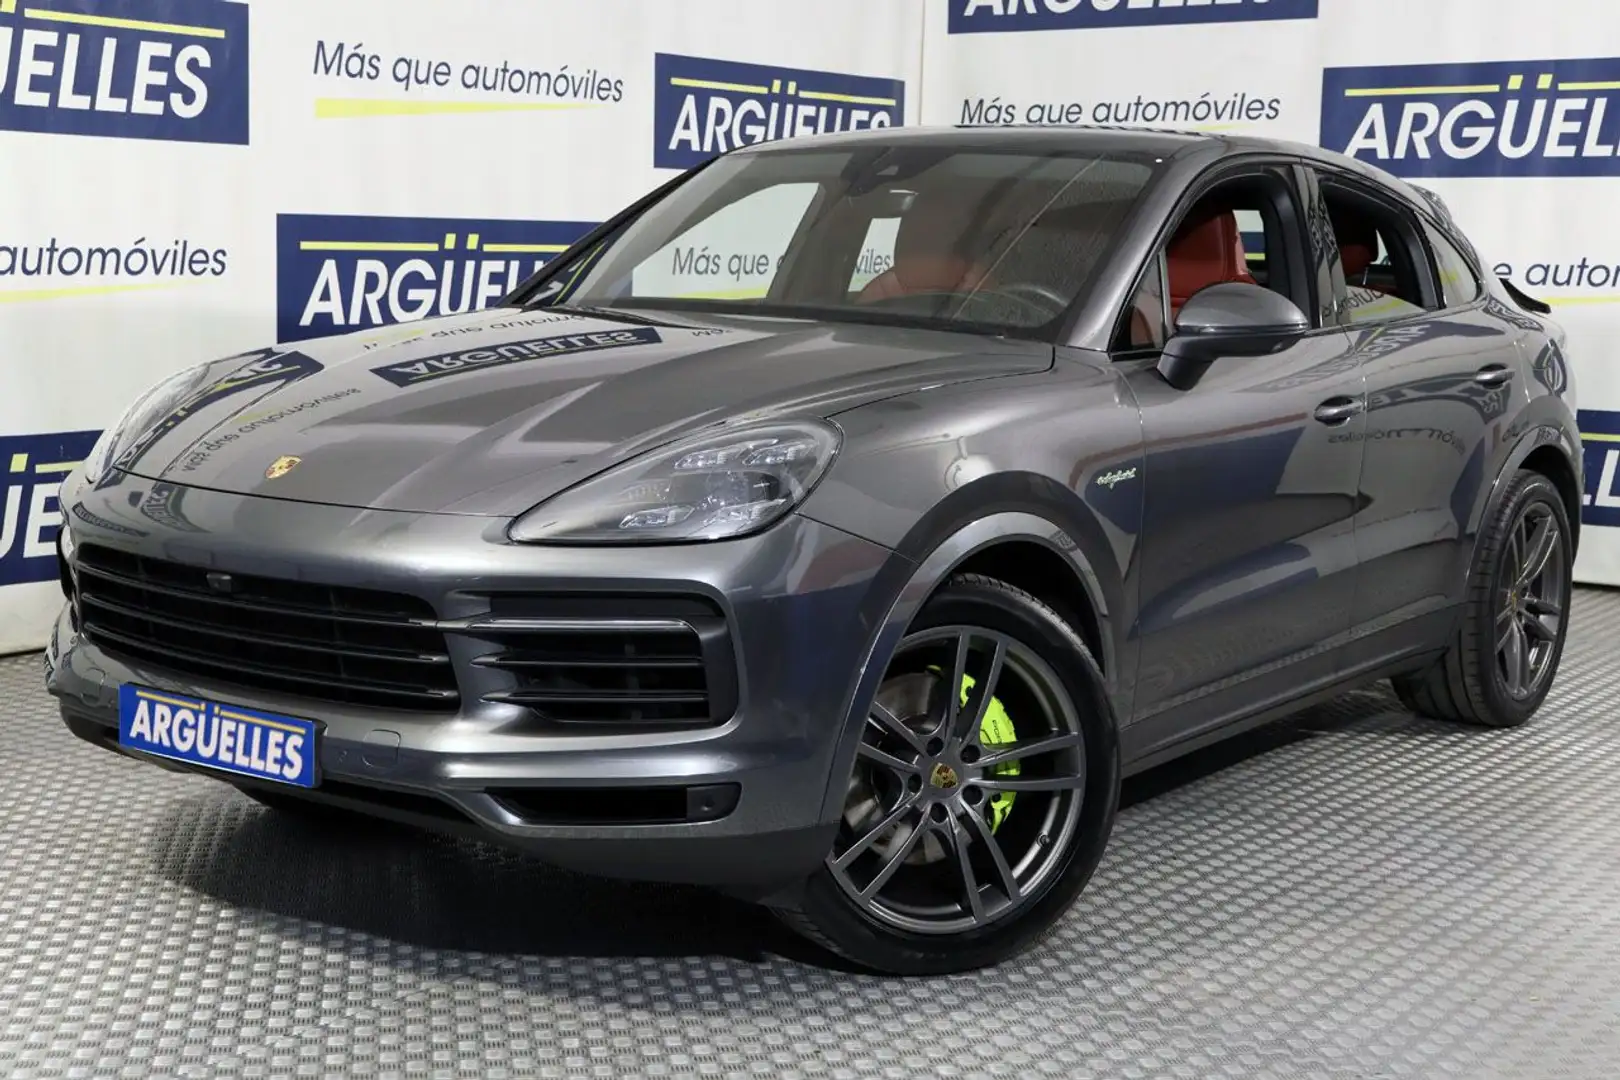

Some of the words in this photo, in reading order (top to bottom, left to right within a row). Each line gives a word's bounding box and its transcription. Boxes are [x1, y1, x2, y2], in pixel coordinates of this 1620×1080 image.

[313, 40, 381, 80] Más
[392, 57, 451, 91] que
[460, 60, 624, 102] automóviles
[960, 97, 1016, 124] Más
[1092, 92, 1281, 124] automóviles
[1343, 73, 1620, 160] ARGÜEL
[672, 246, 721, 275] Más
[727, 253, 769, 282] que
[1525, 257, 1620, 287] auto
[130, 699, 304, 780] ARGÜELLES
